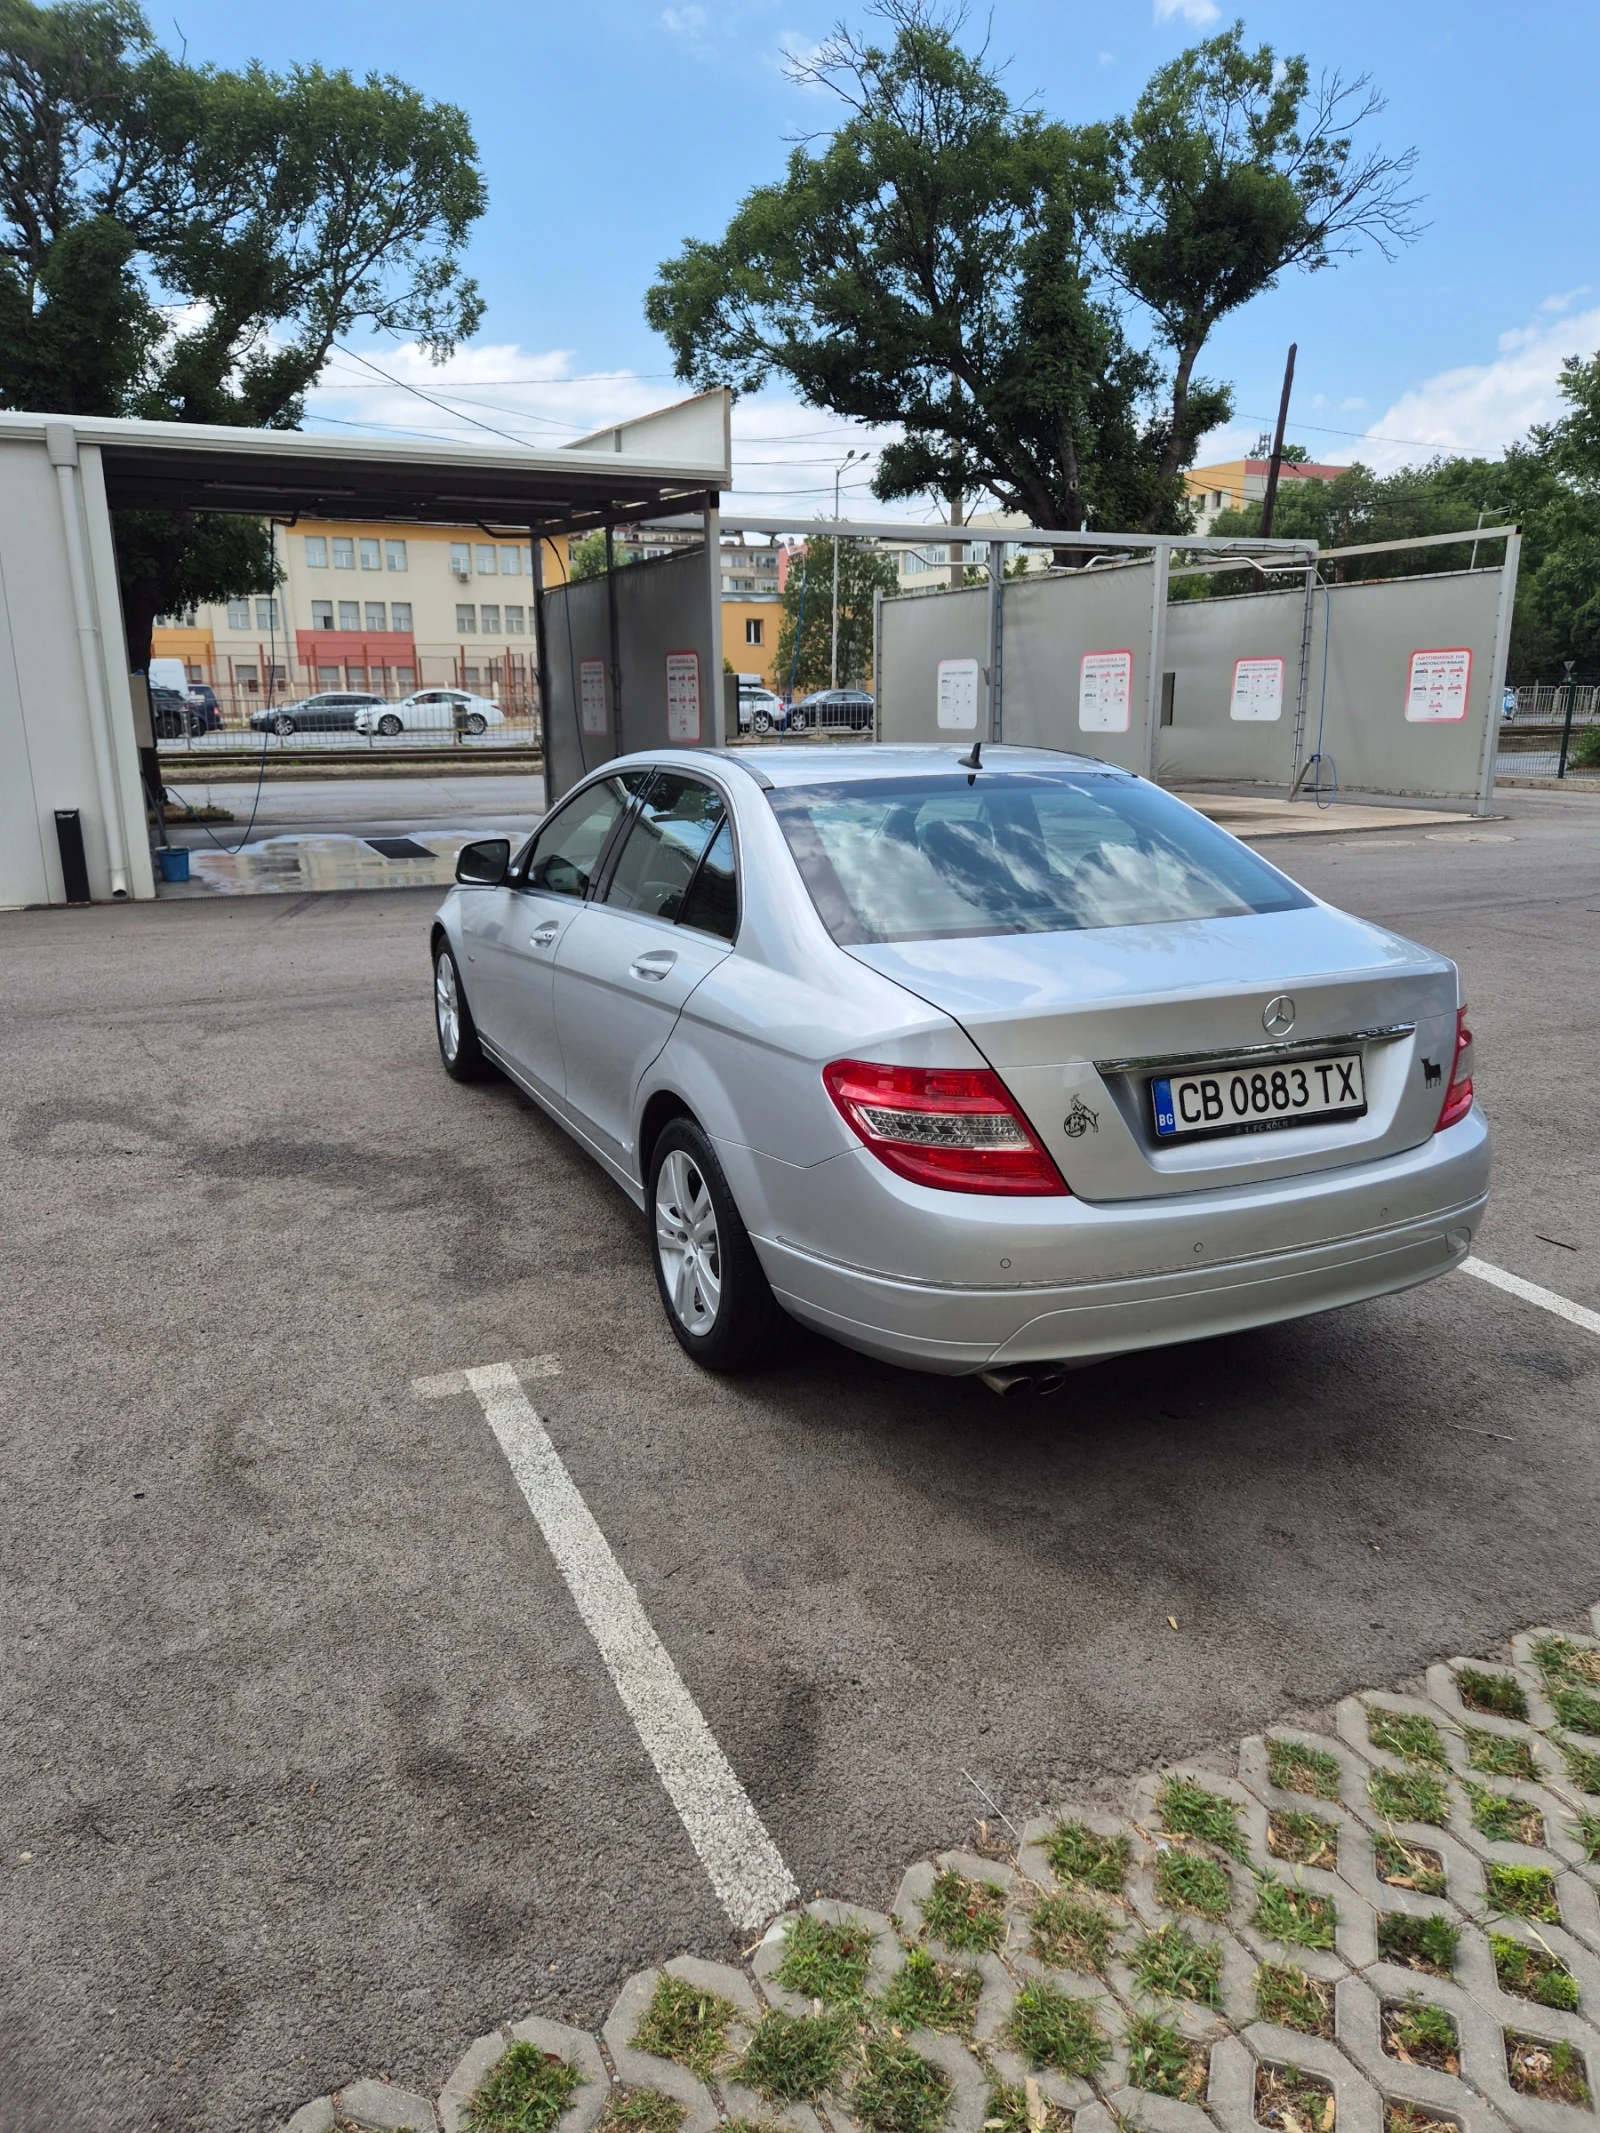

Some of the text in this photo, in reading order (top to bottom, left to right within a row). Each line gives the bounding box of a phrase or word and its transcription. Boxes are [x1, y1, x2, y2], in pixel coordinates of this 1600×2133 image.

[1179, 1062, 1357, 1123] CB 0883 TX
[1159, 1113, 1174, 1127] BG
[1253, 1124, 1264, 1132] FC
[1266, 1120, 1288, 1130] KÖLN
